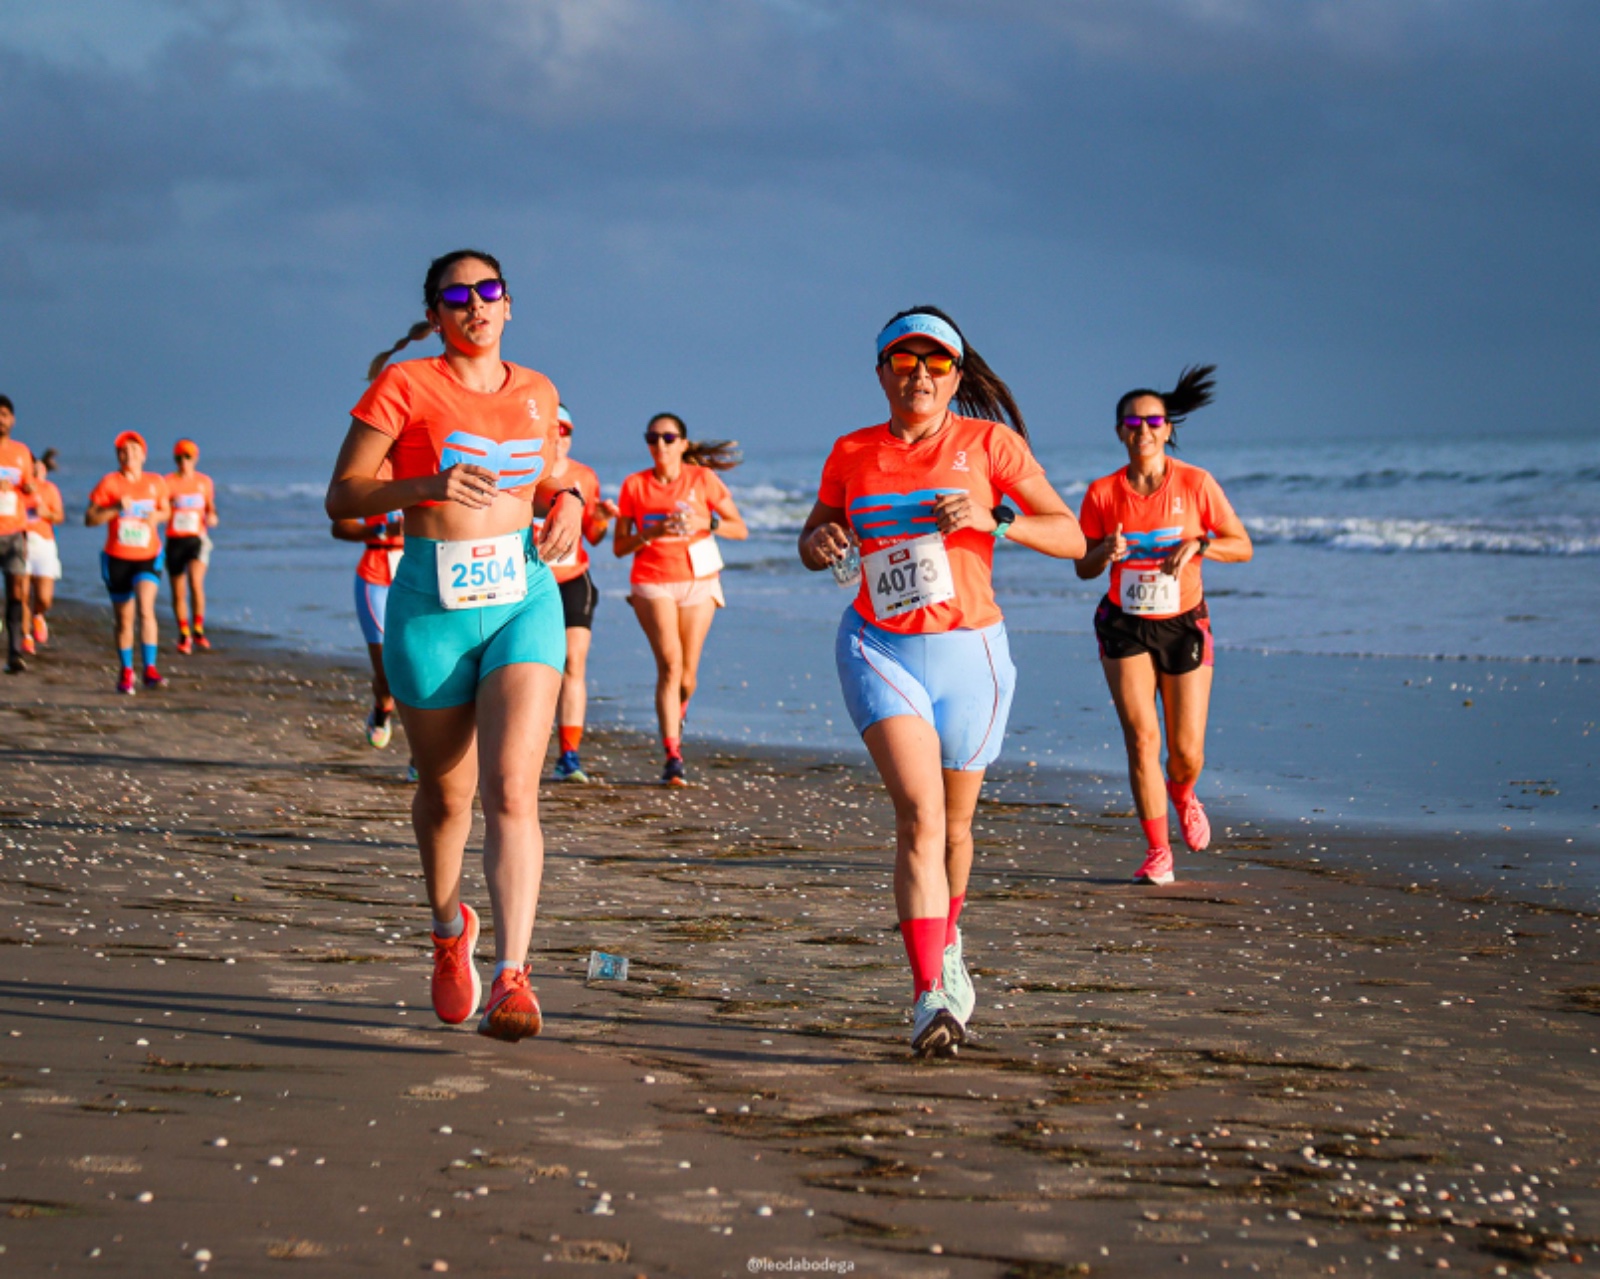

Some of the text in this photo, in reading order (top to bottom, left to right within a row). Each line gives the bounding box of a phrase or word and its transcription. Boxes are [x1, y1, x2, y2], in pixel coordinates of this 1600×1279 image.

[451, 556, 516, 588] 2504
[877, 558, 938, 596] 4073
[1126, 583, 1169, 601] 4071
